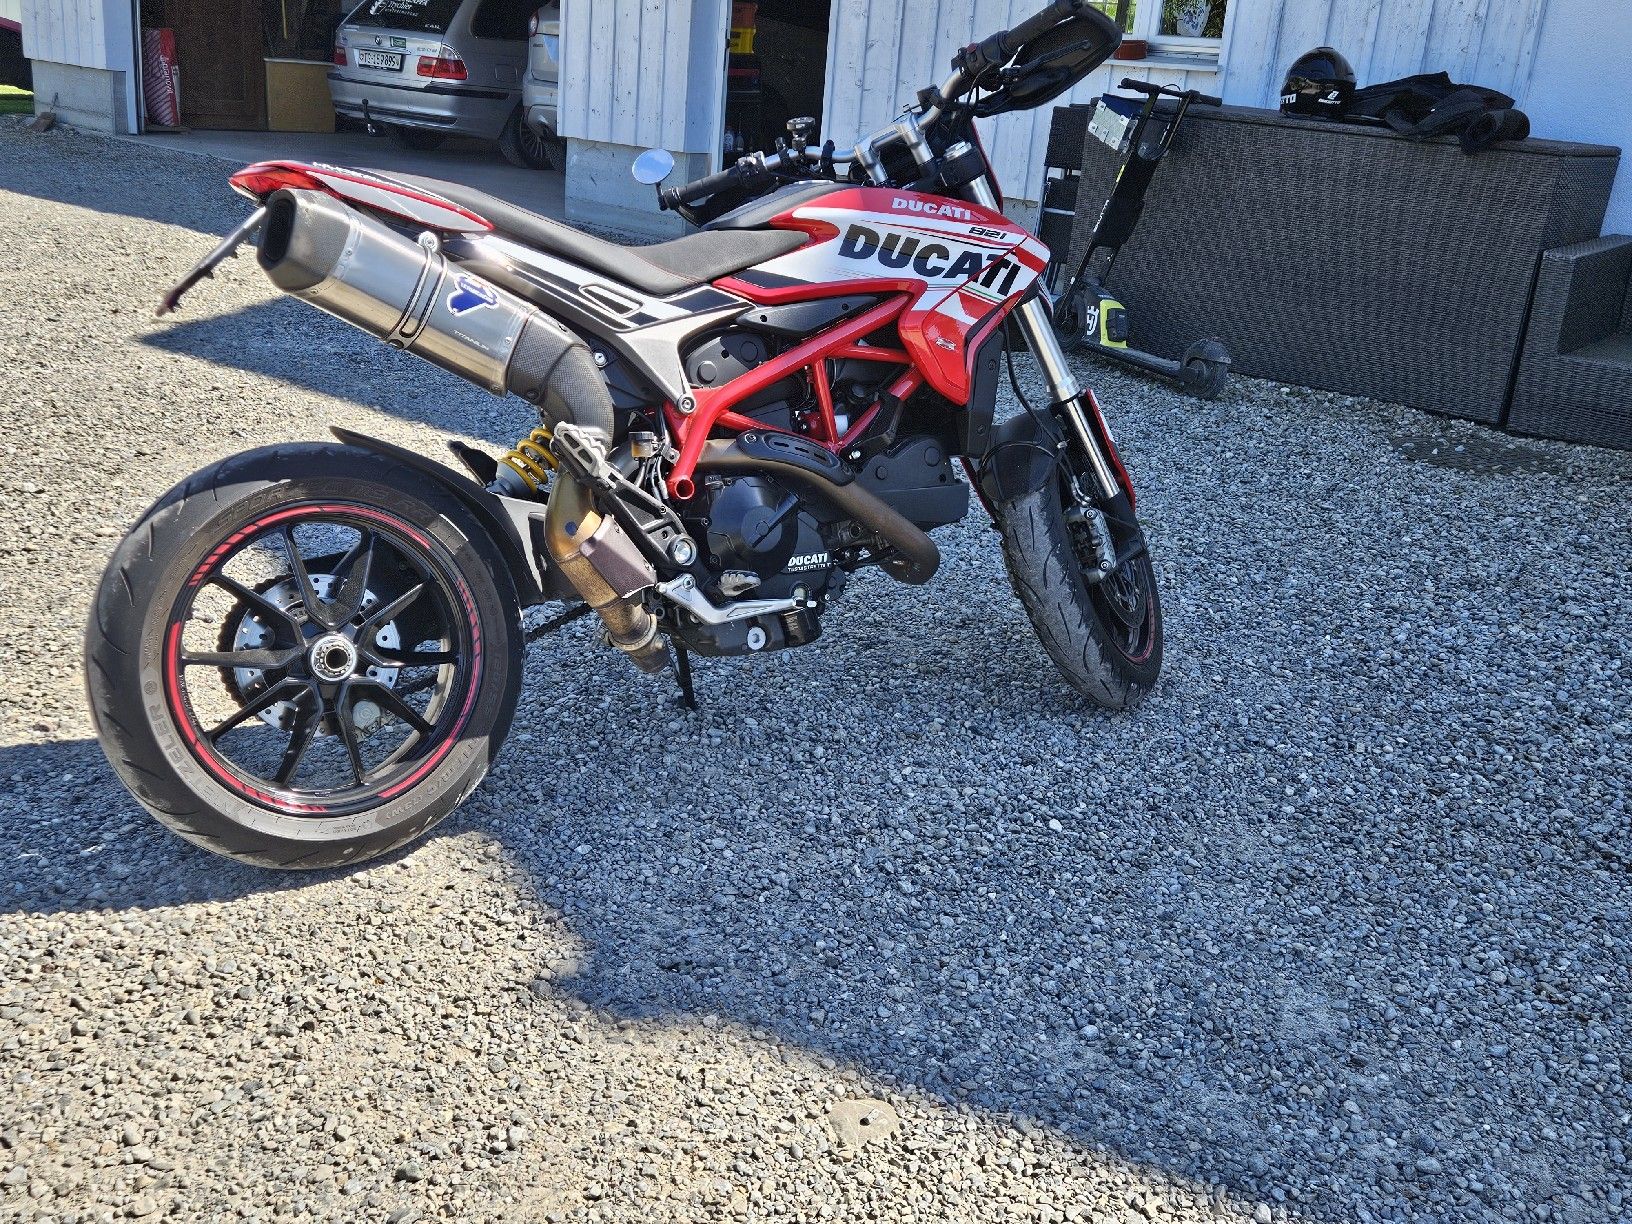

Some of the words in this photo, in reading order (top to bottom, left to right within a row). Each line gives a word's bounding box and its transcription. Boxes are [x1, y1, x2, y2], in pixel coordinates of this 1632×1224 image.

[891, 197, 971, 221] DUCATI
[969, 226, 1007, 239] 821
[838, 224, 1021, 297] DUCATI
[787, 552, 828, 567] DUCATI
